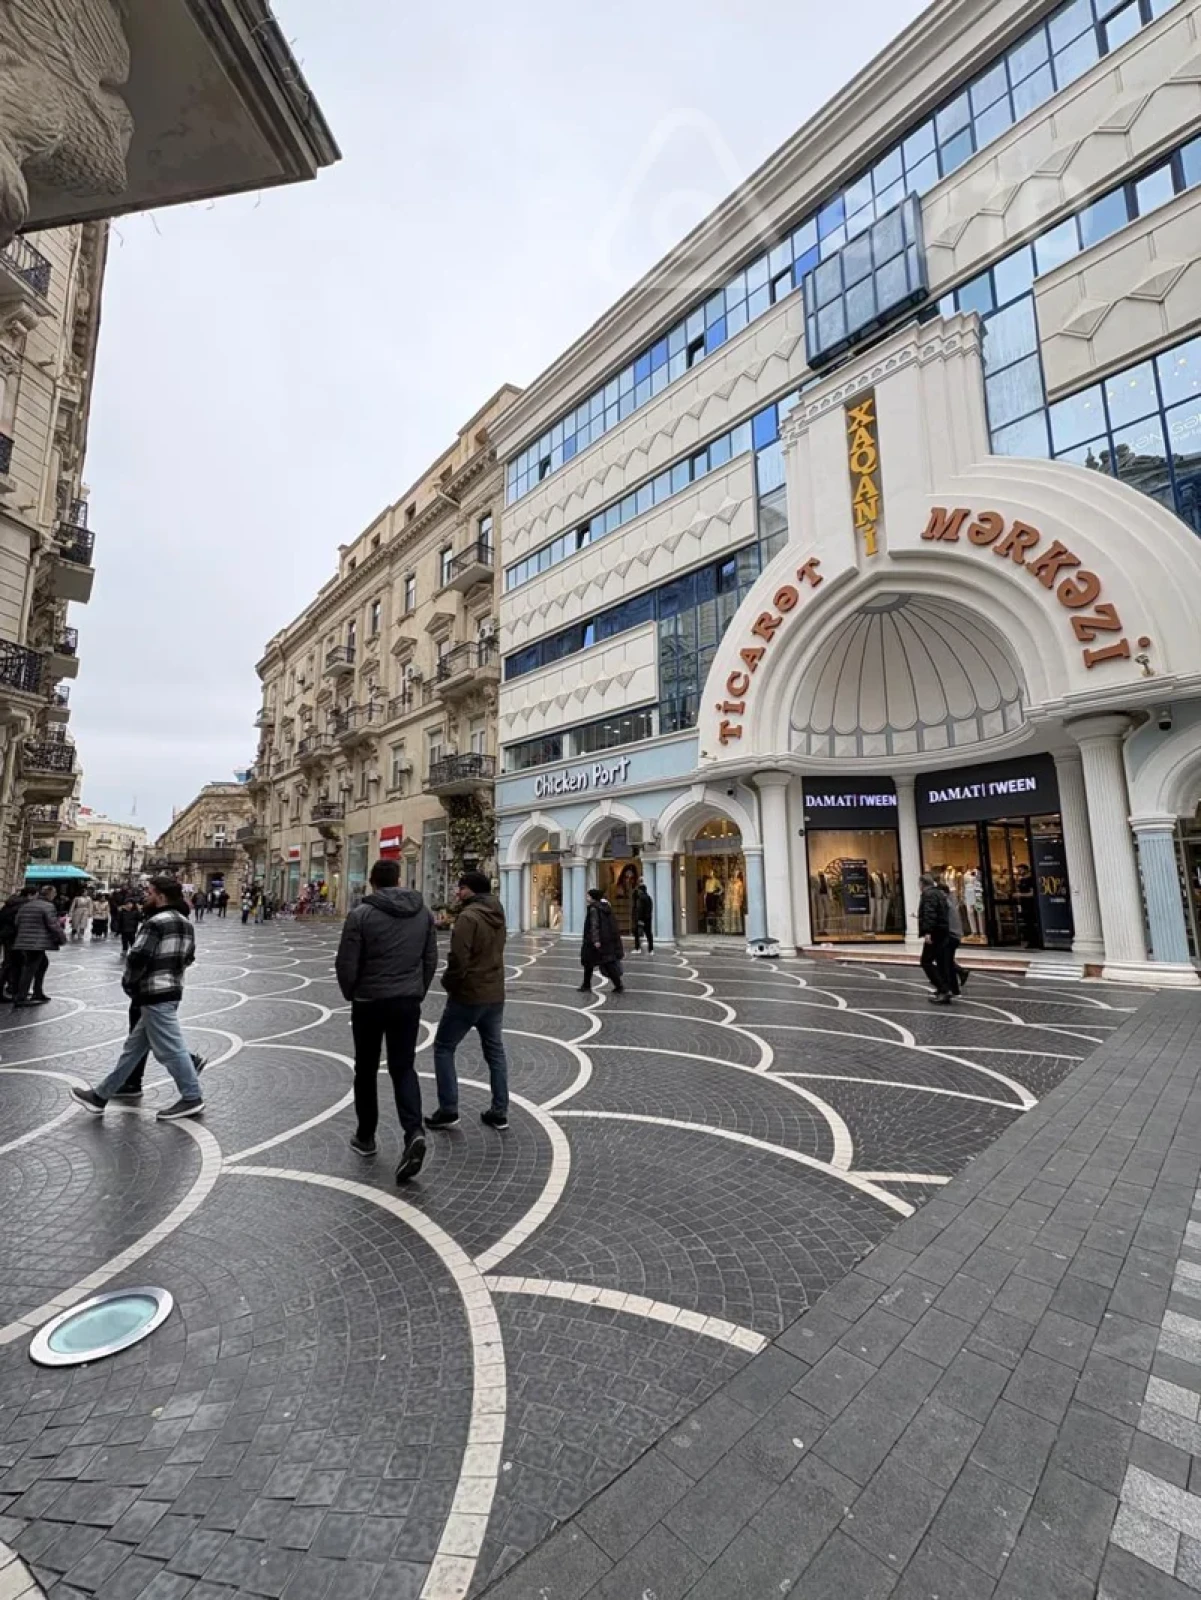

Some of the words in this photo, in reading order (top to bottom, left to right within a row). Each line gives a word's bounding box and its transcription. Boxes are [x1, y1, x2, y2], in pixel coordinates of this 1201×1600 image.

[715, 557, 824, 745] TİCARƏT
[921, 506, 1151, 670] MƏRKƏZİ
[533, 770, 589, 798] Chicken
[592, 757, 631, 787] Port
[805, 794, 852, 807] DAMAT
[928, 785, 981, 803] DAMAT
